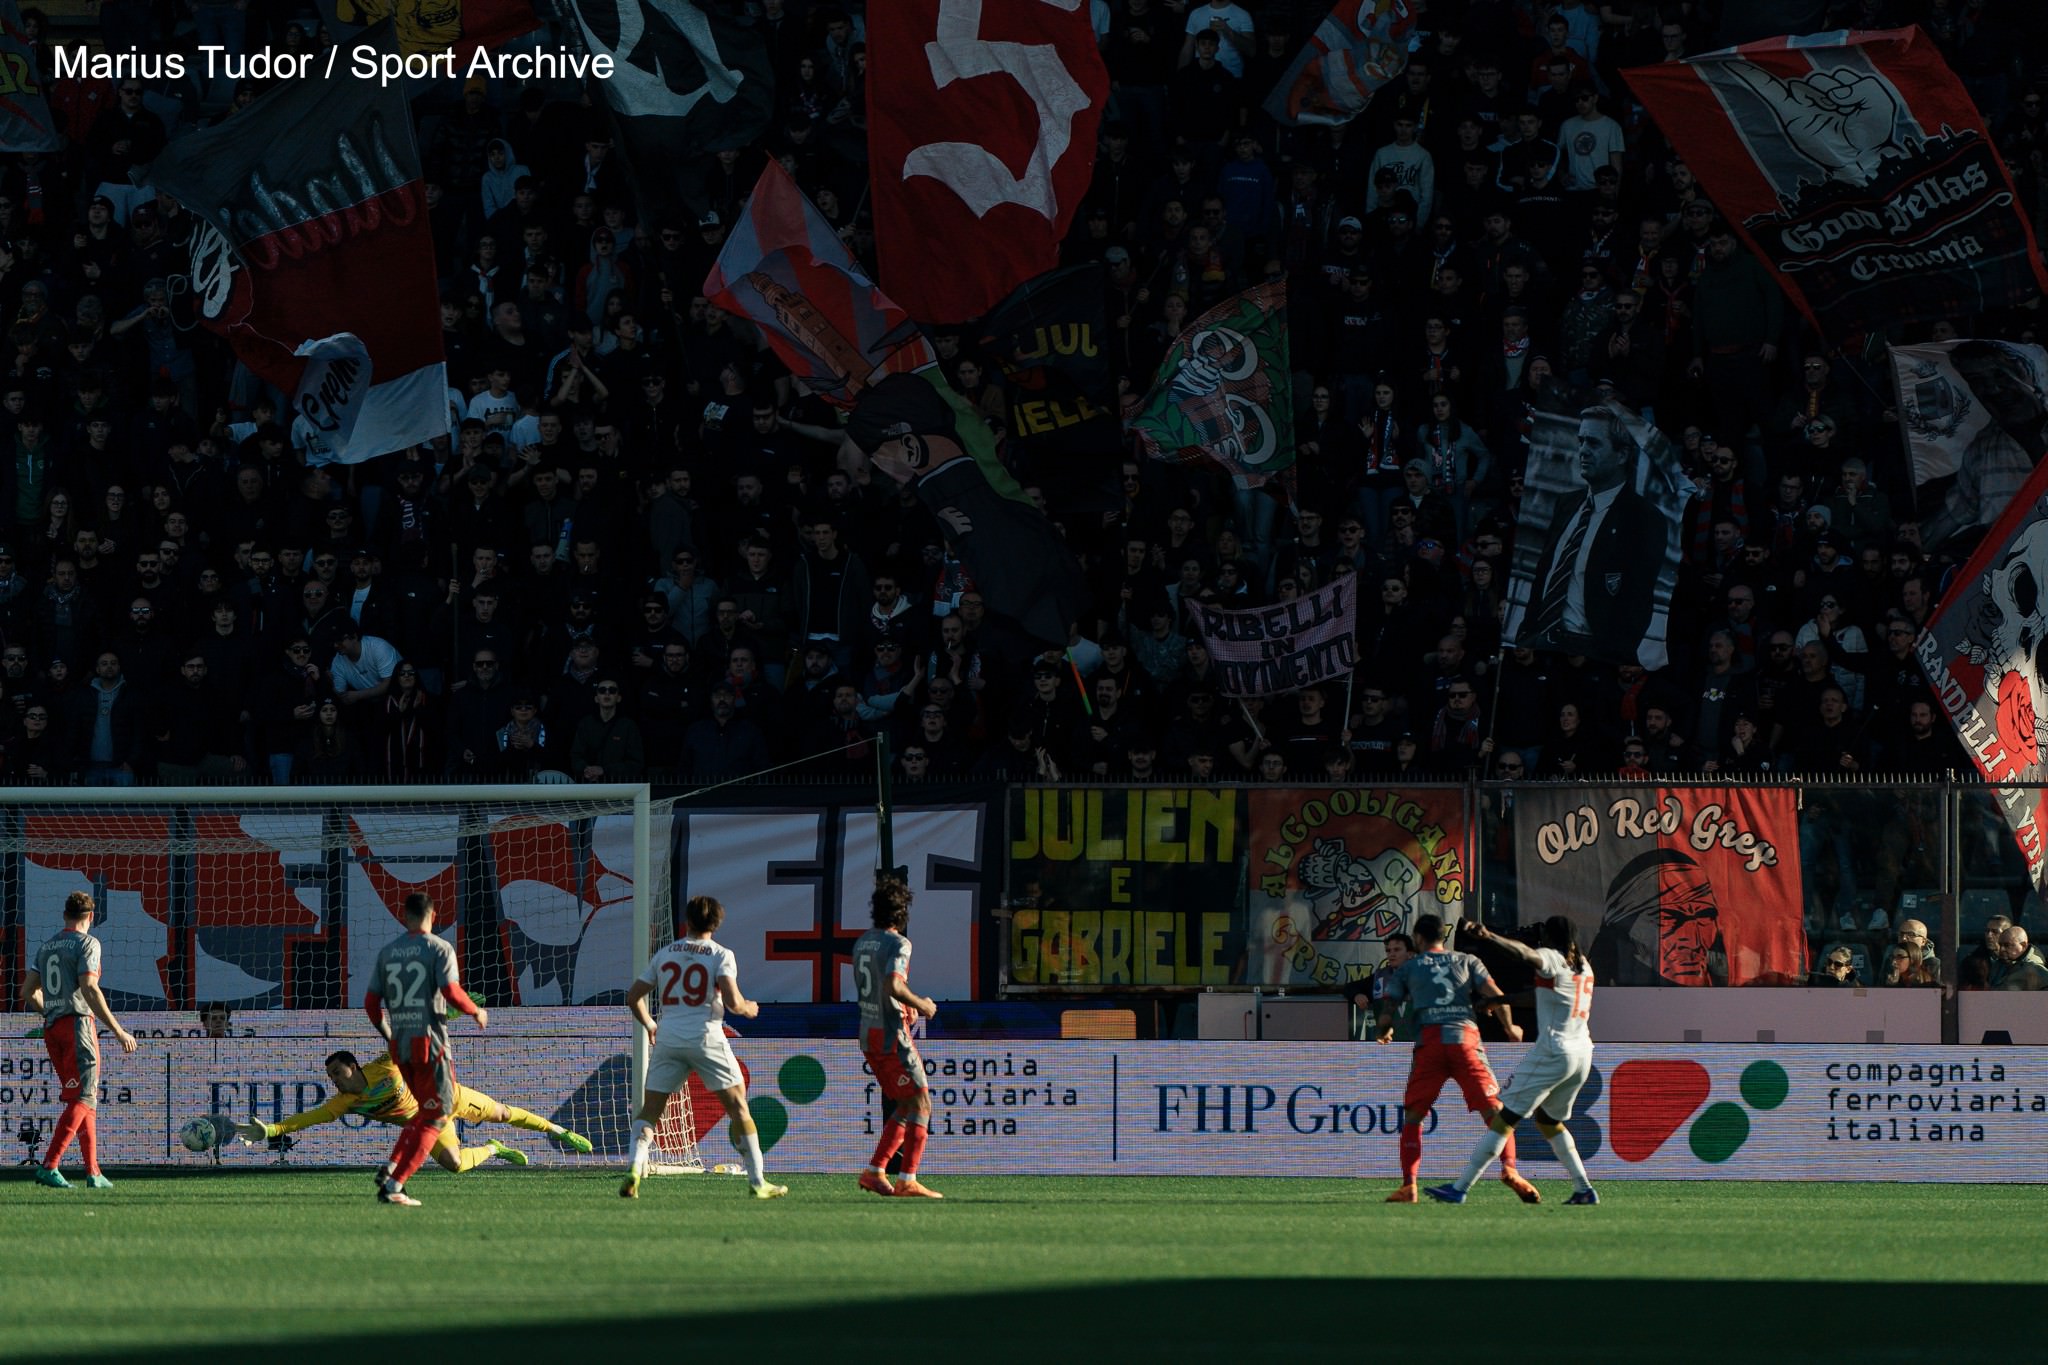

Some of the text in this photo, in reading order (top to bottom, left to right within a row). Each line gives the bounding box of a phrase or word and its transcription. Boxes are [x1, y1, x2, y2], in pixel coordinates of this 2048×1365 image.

[1780, 160, 1989, 254] Good Fellas
[1850, 232, 1984, 282] Cremona
[1202, 584, 1343, 641] RIBELLI
[1261, 637, 1296, 660] IN
[1010, 787, 1238, 863] JULIEN
[1260, 788, 1464, 905] ALCOOLIGANS
[1536, 803, 1600, 866] Old
[1608, 796, 1683, 839] Red
[1110, 866, 1133, 904] E
[1011, 908, 1232, 985] GABRIELE
[46, 953, 62, 996] 6
[385, 960, 427, 1009] 32
[661, 961, 709, 1007] 29
[858, 954, 873, 998] 5
[1430, 965, 1456, 1006] 3
[862, 1053, 1037, 1081] cpagnia
[1826, 1057, 2006, 1087] compagnia
[864, 1082, 1077, 1106] foviaria
[1153, 1084, 1276, 1133] FHP
[1827, 1087, 2047, 1112] ferroviaria
[863, 1112, 1016, 1135] iliana
[1826, 1116, 1985, 1141] italiana
